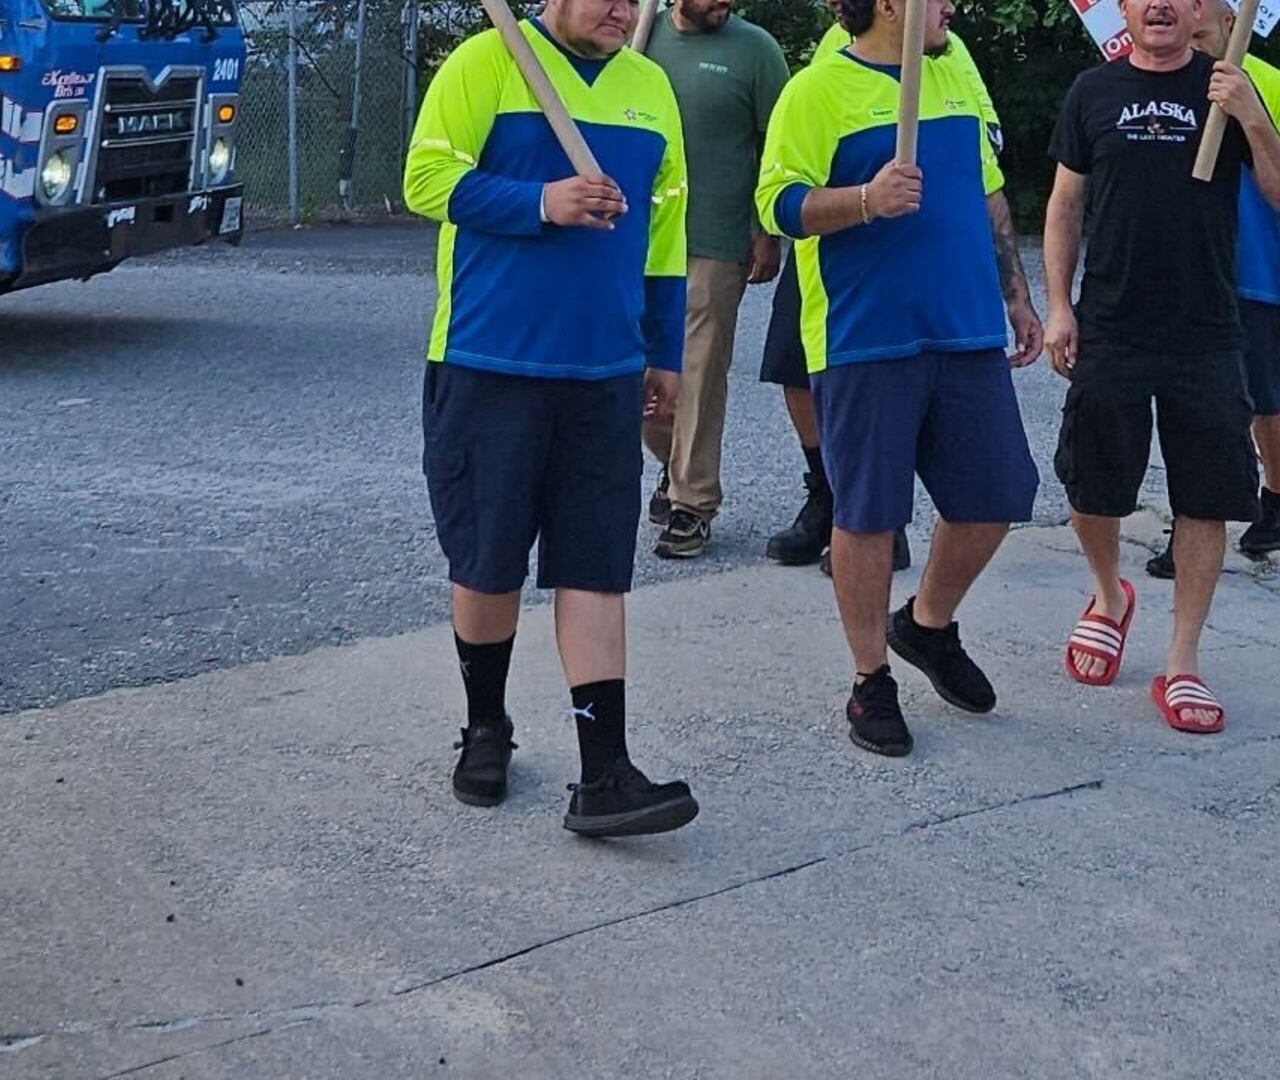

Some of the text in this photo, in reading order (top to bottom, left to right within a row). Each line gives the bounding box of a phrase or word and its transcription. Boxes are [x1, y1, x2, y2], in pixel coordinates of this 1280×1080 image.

[1106, 32, 1132, 54] On
[212, 58, 239, 80] 2401
[1116, 100, 1197, 126] ALASKA
